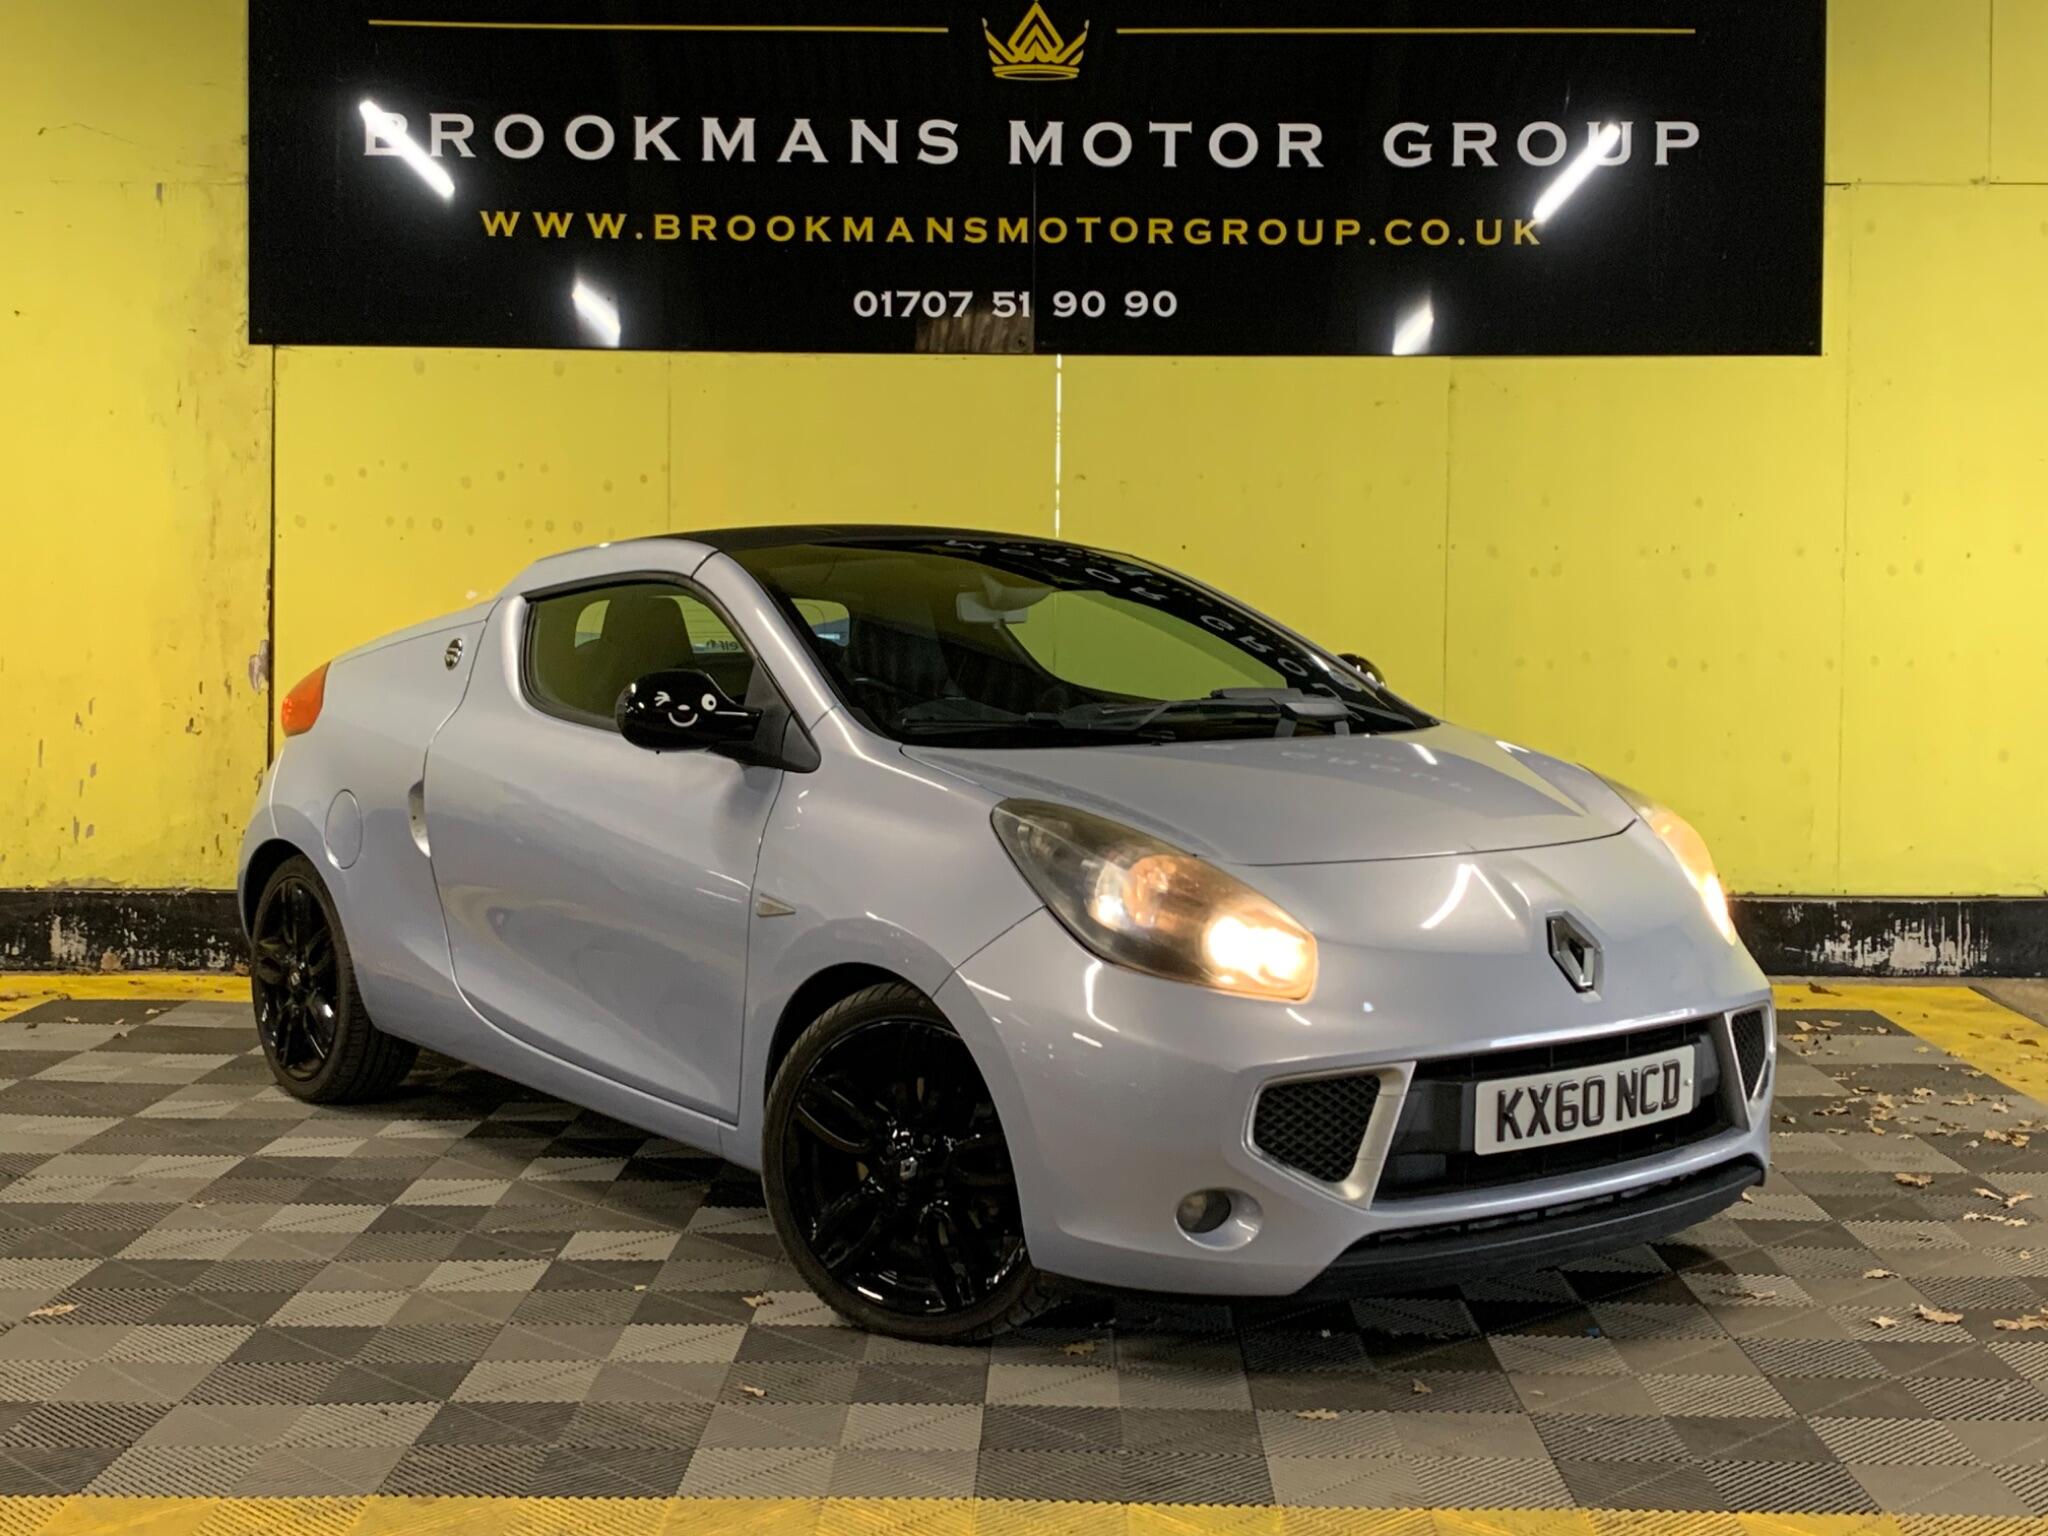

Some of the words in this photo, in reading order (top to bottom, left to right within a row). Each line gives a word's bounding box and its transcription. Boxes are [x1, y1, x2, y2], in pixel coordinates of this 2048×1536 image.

[363, 112, 959, 165] BROOKMANS
[1008, 119, 1324, 168] MOTOR
[1382, 120, 1700, 168] GROUP
[480, 210, 1541, 246] WWW.BROOKMANSMOTORGROUP.CO.UK
[853, 290, 973, 318] 01707
[992, 290, 1030, 318] 51
[1052, 290, 1106, 318] 90
[1124, 290, 1178, 318] 90
[1496, 1075, 1606, 1142] KX60
[1616, 1058, 1681, 1122] NCD
